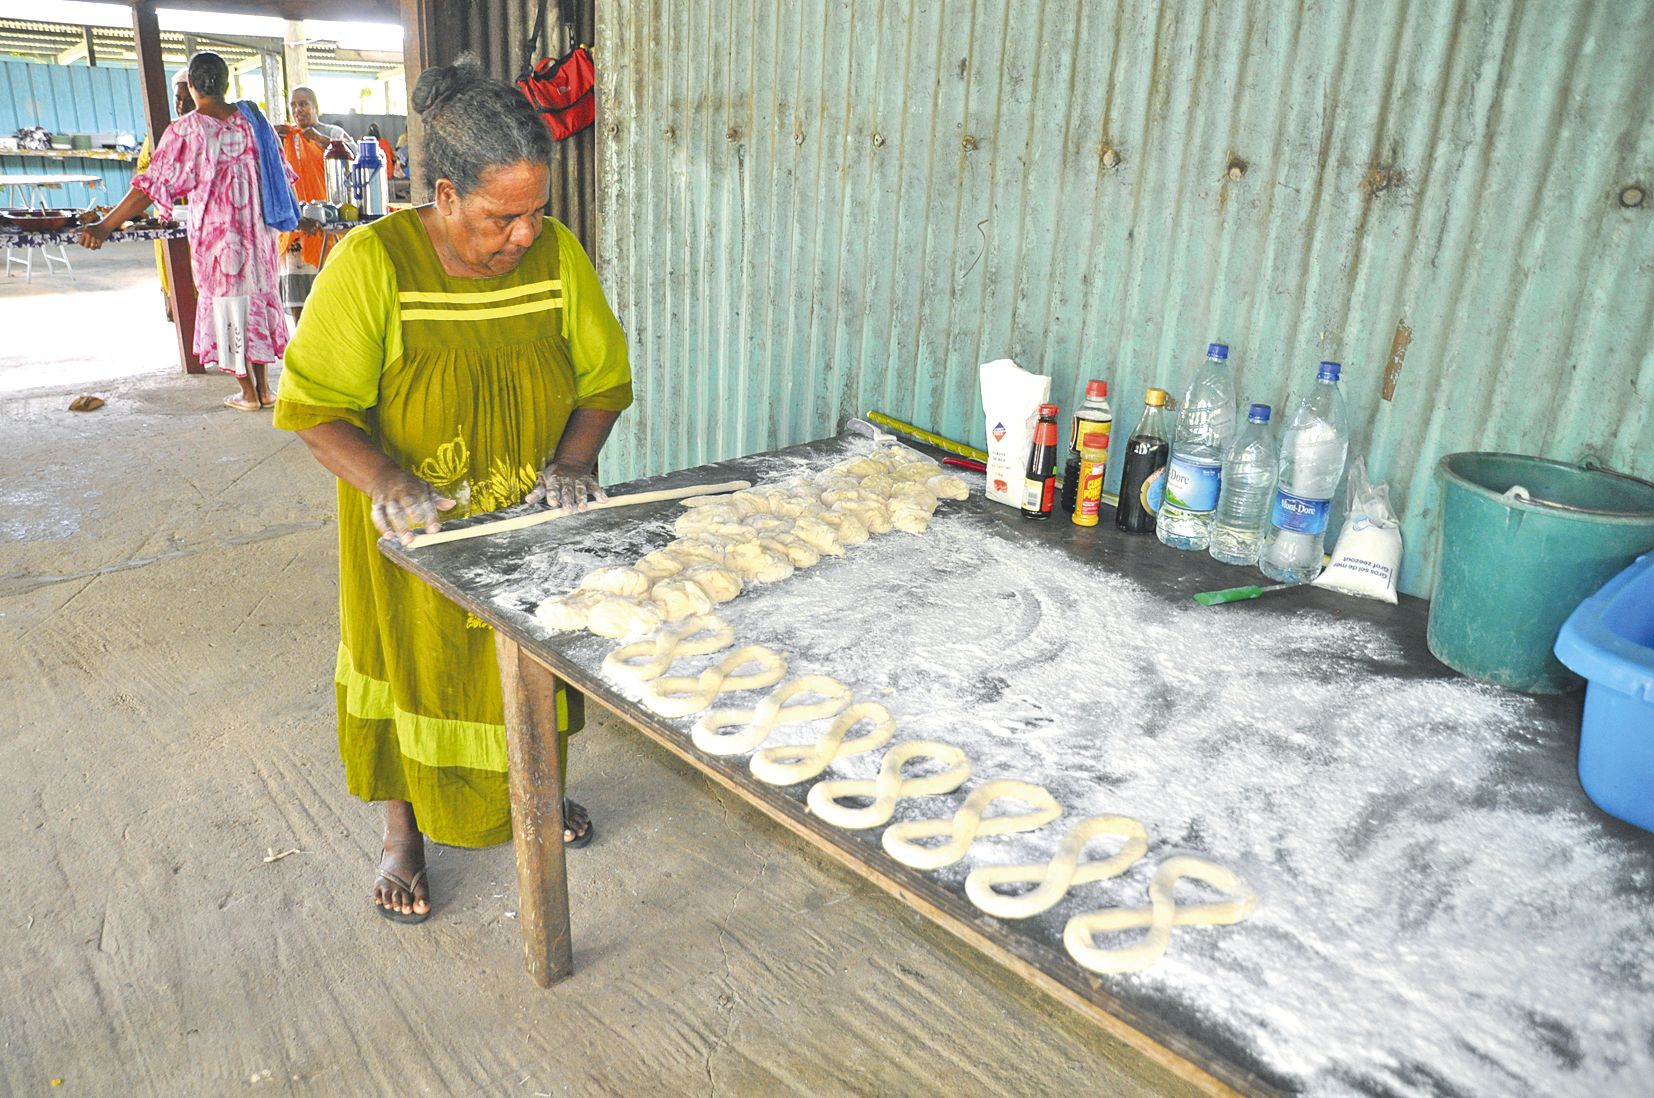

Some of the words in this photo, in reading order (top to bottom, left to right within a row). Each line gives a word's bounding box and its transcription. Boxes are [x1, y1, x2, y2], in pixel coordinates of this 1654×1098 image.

[1281, 499, 1316, 516] Mont-Dore
[1343, 556, 1372, 567] zeezout
[1372, 563, 1389, 573] Grof
[1370, 569, 1388, 579] Gros
